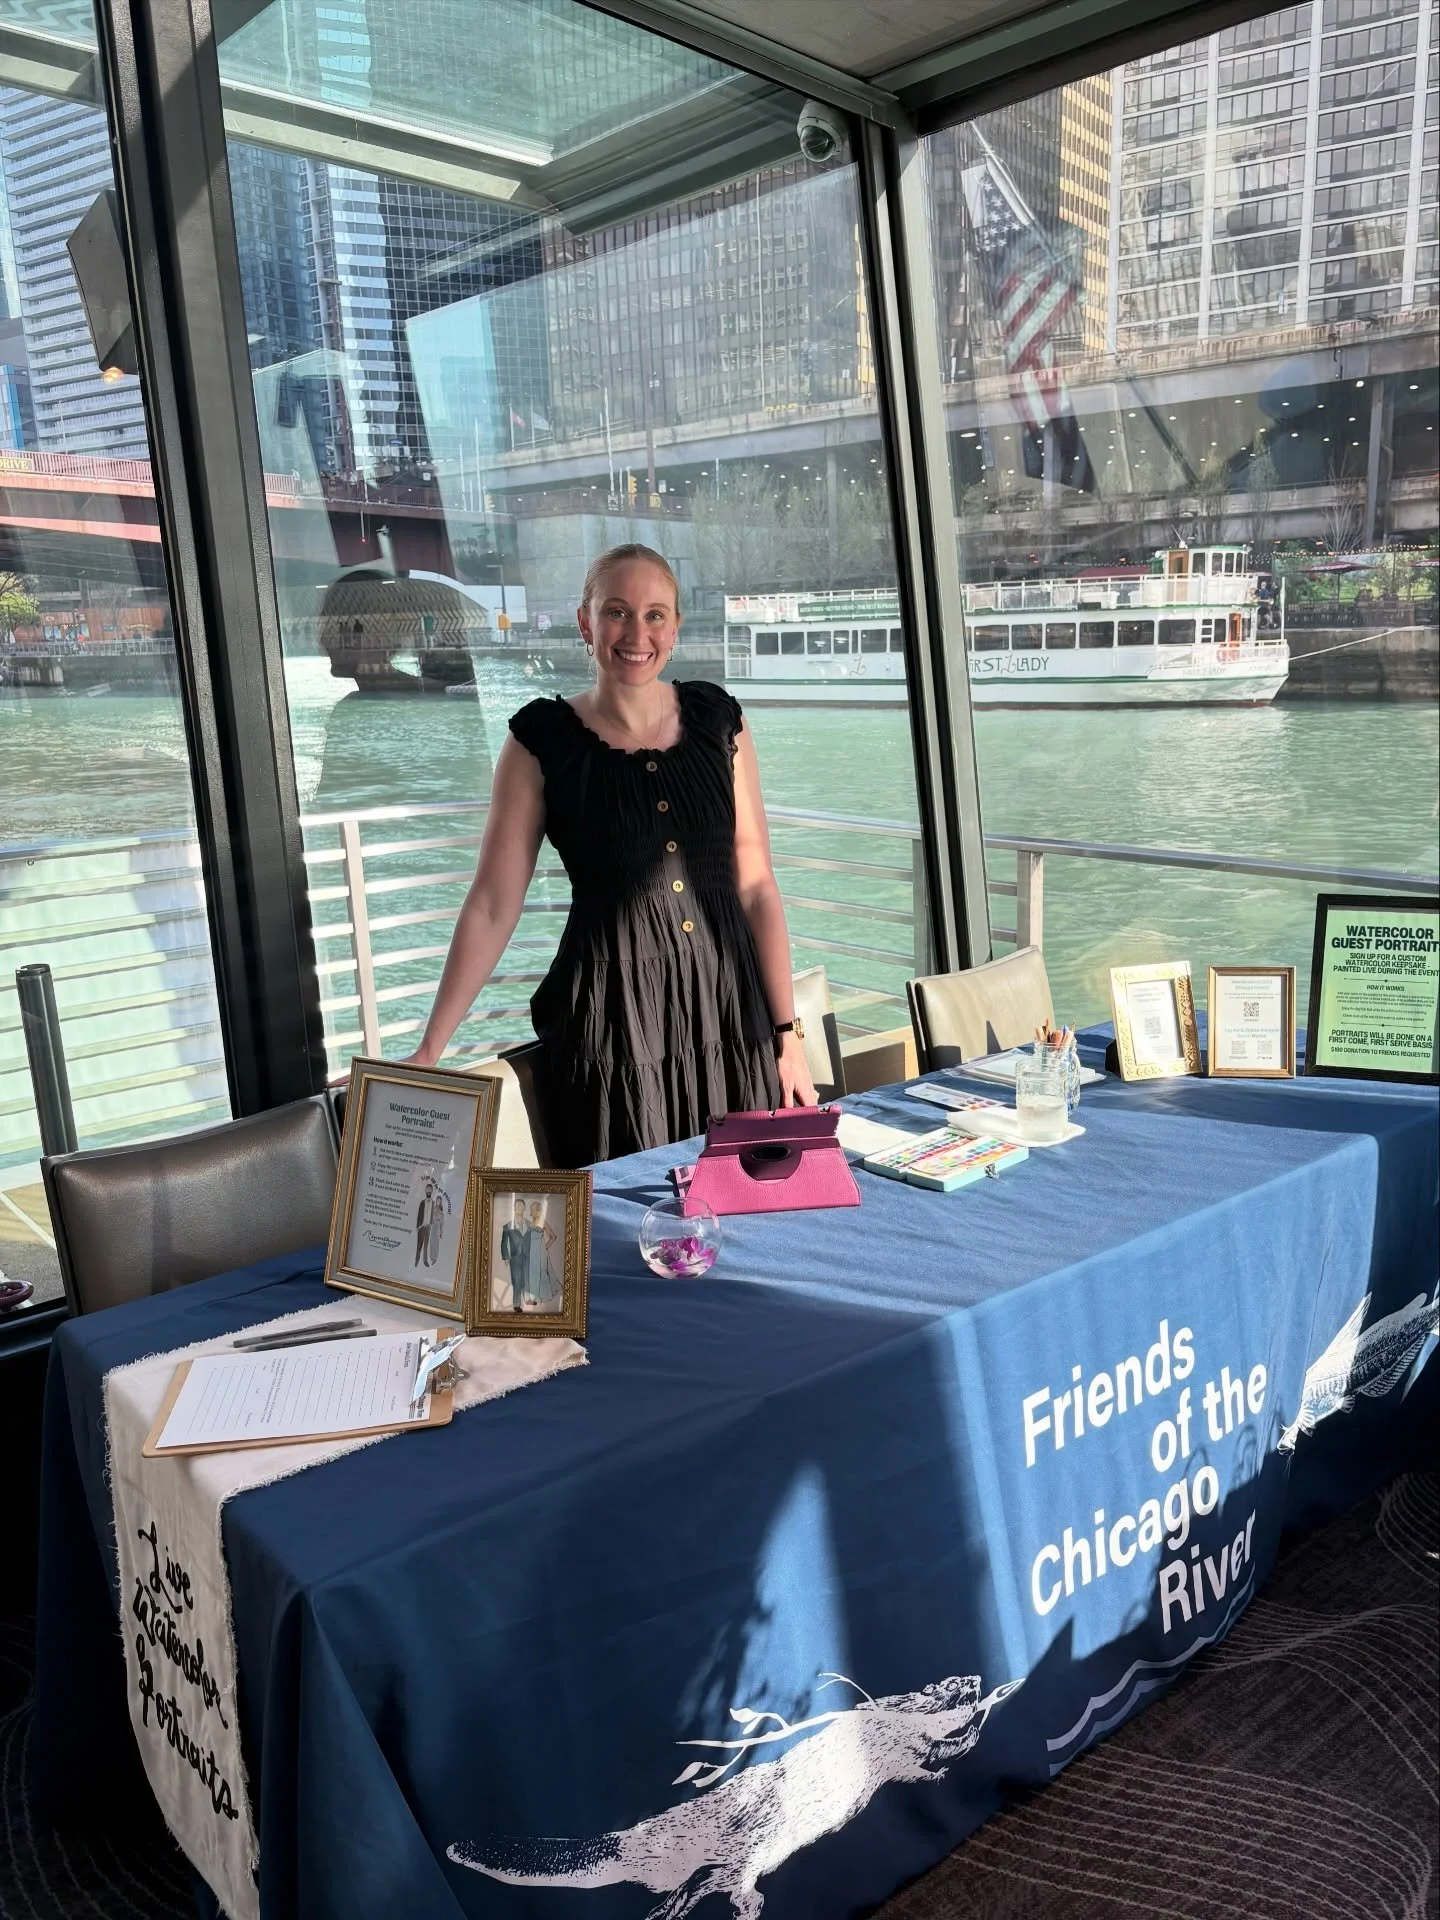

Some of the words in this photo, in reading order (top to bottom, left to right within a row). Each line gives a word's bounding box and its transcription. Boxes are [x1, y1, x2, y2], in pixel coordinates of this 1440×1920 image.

[969, 657, 1003, 673] IRST
[1016, 657, 1050, 672] LADY
[1346, 925, 1434, 939] WATERCOLOR
[1331, 937, 1372, 949] GUEST
[1346, 959, 1390, 967] WATERCOLOR
[1392, 961, 1426, 969] KEEPSAKE
[1350, 952, 1365, 960] SIGN
[1398, 954, 1426, 962] CUSTOM
[1333, 965, 1361, 973] PAINTED
[1378, 967, 1402, 975] DURING
[1331, 1029, 1368, 1038] PORTRAITS
[1396, 1033, 1414, 1041] DONE
[1348, 1037, 1369, 1046] COME,
[1390, 1040, 1411, 1048] SERVE
[1344, 1047, 1370, 1055] DONATION
[389, 1102, 430, 1117] Watercolor
[430, 1109, 450, 1120] Guest
[401, 1115, 436, 1129] Portraits!
[1022, 1318, 1196, 1468] Friends
[1151, 1387, 1193, 1473] of
[1203, 1363, 1267, 1442] the
[1031, 1465, 1220, 1617] Chicago
[1159, 1508, 1256, 1635] River
